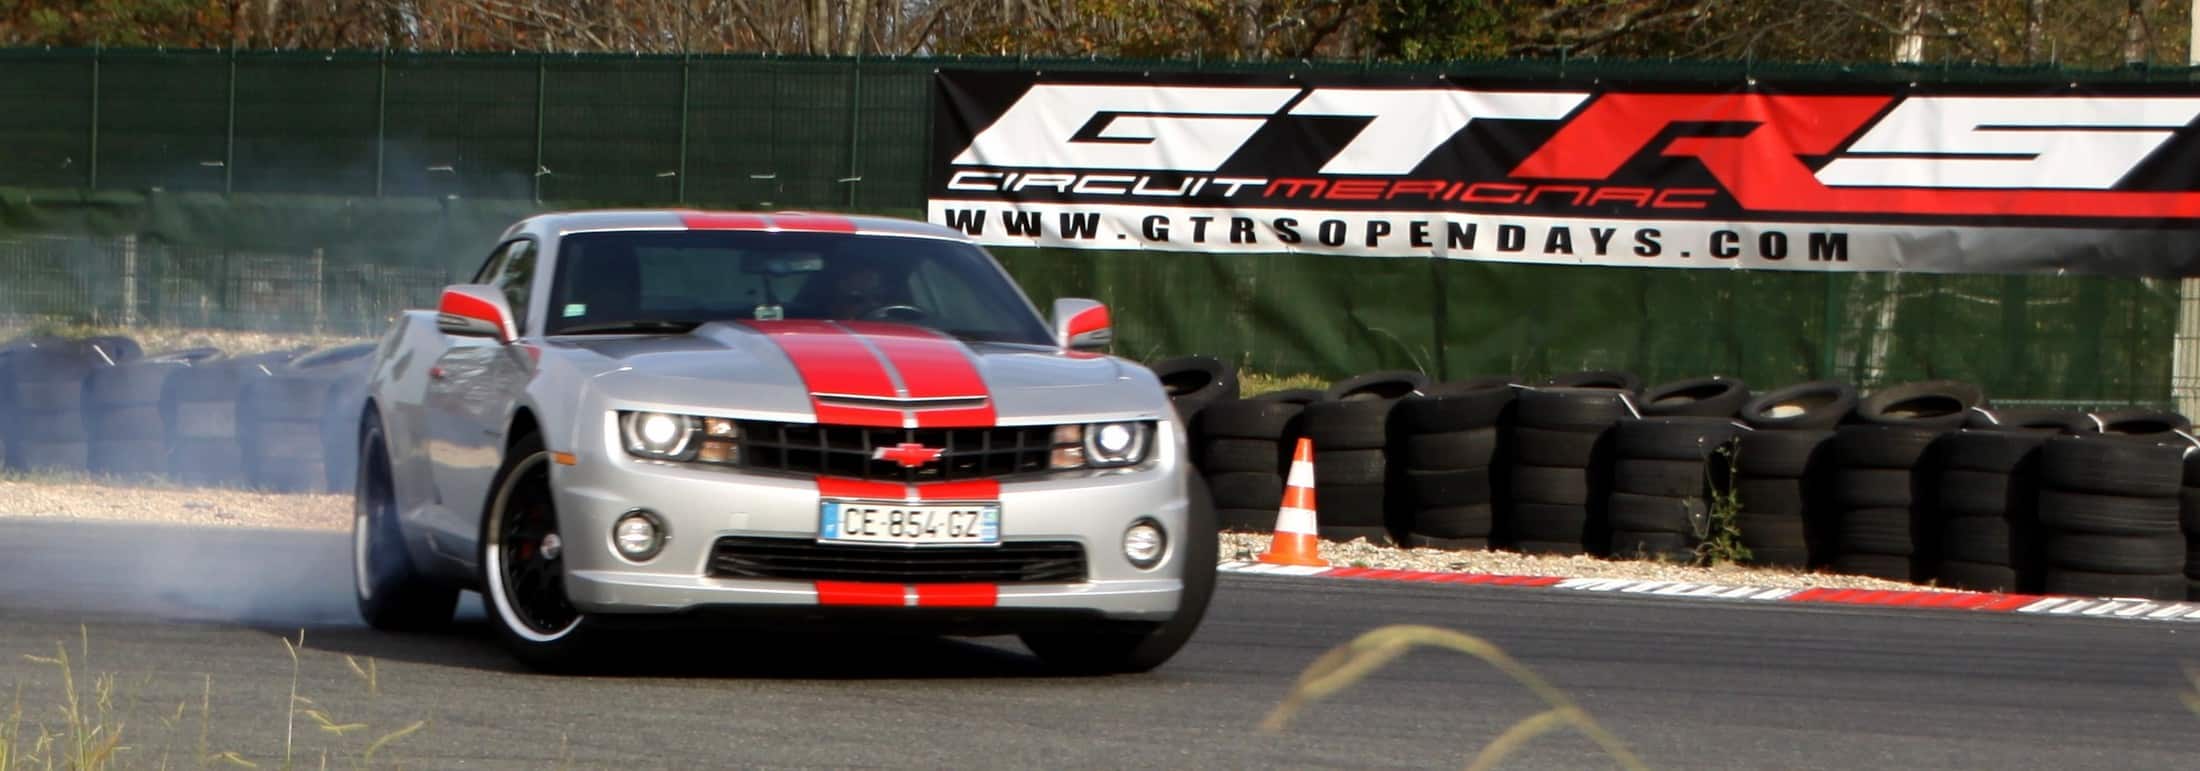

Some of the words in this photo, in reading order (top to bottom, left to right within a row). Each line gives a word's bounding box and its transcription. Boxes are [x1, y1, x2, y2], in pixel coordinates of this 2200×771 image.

[951, 84, 2200, 211] GTRS
[945, 208, 1849, 262] WWW.GTRSOPENDAYS.COM
[844, 508, 979, 538] CE-854-GZ
